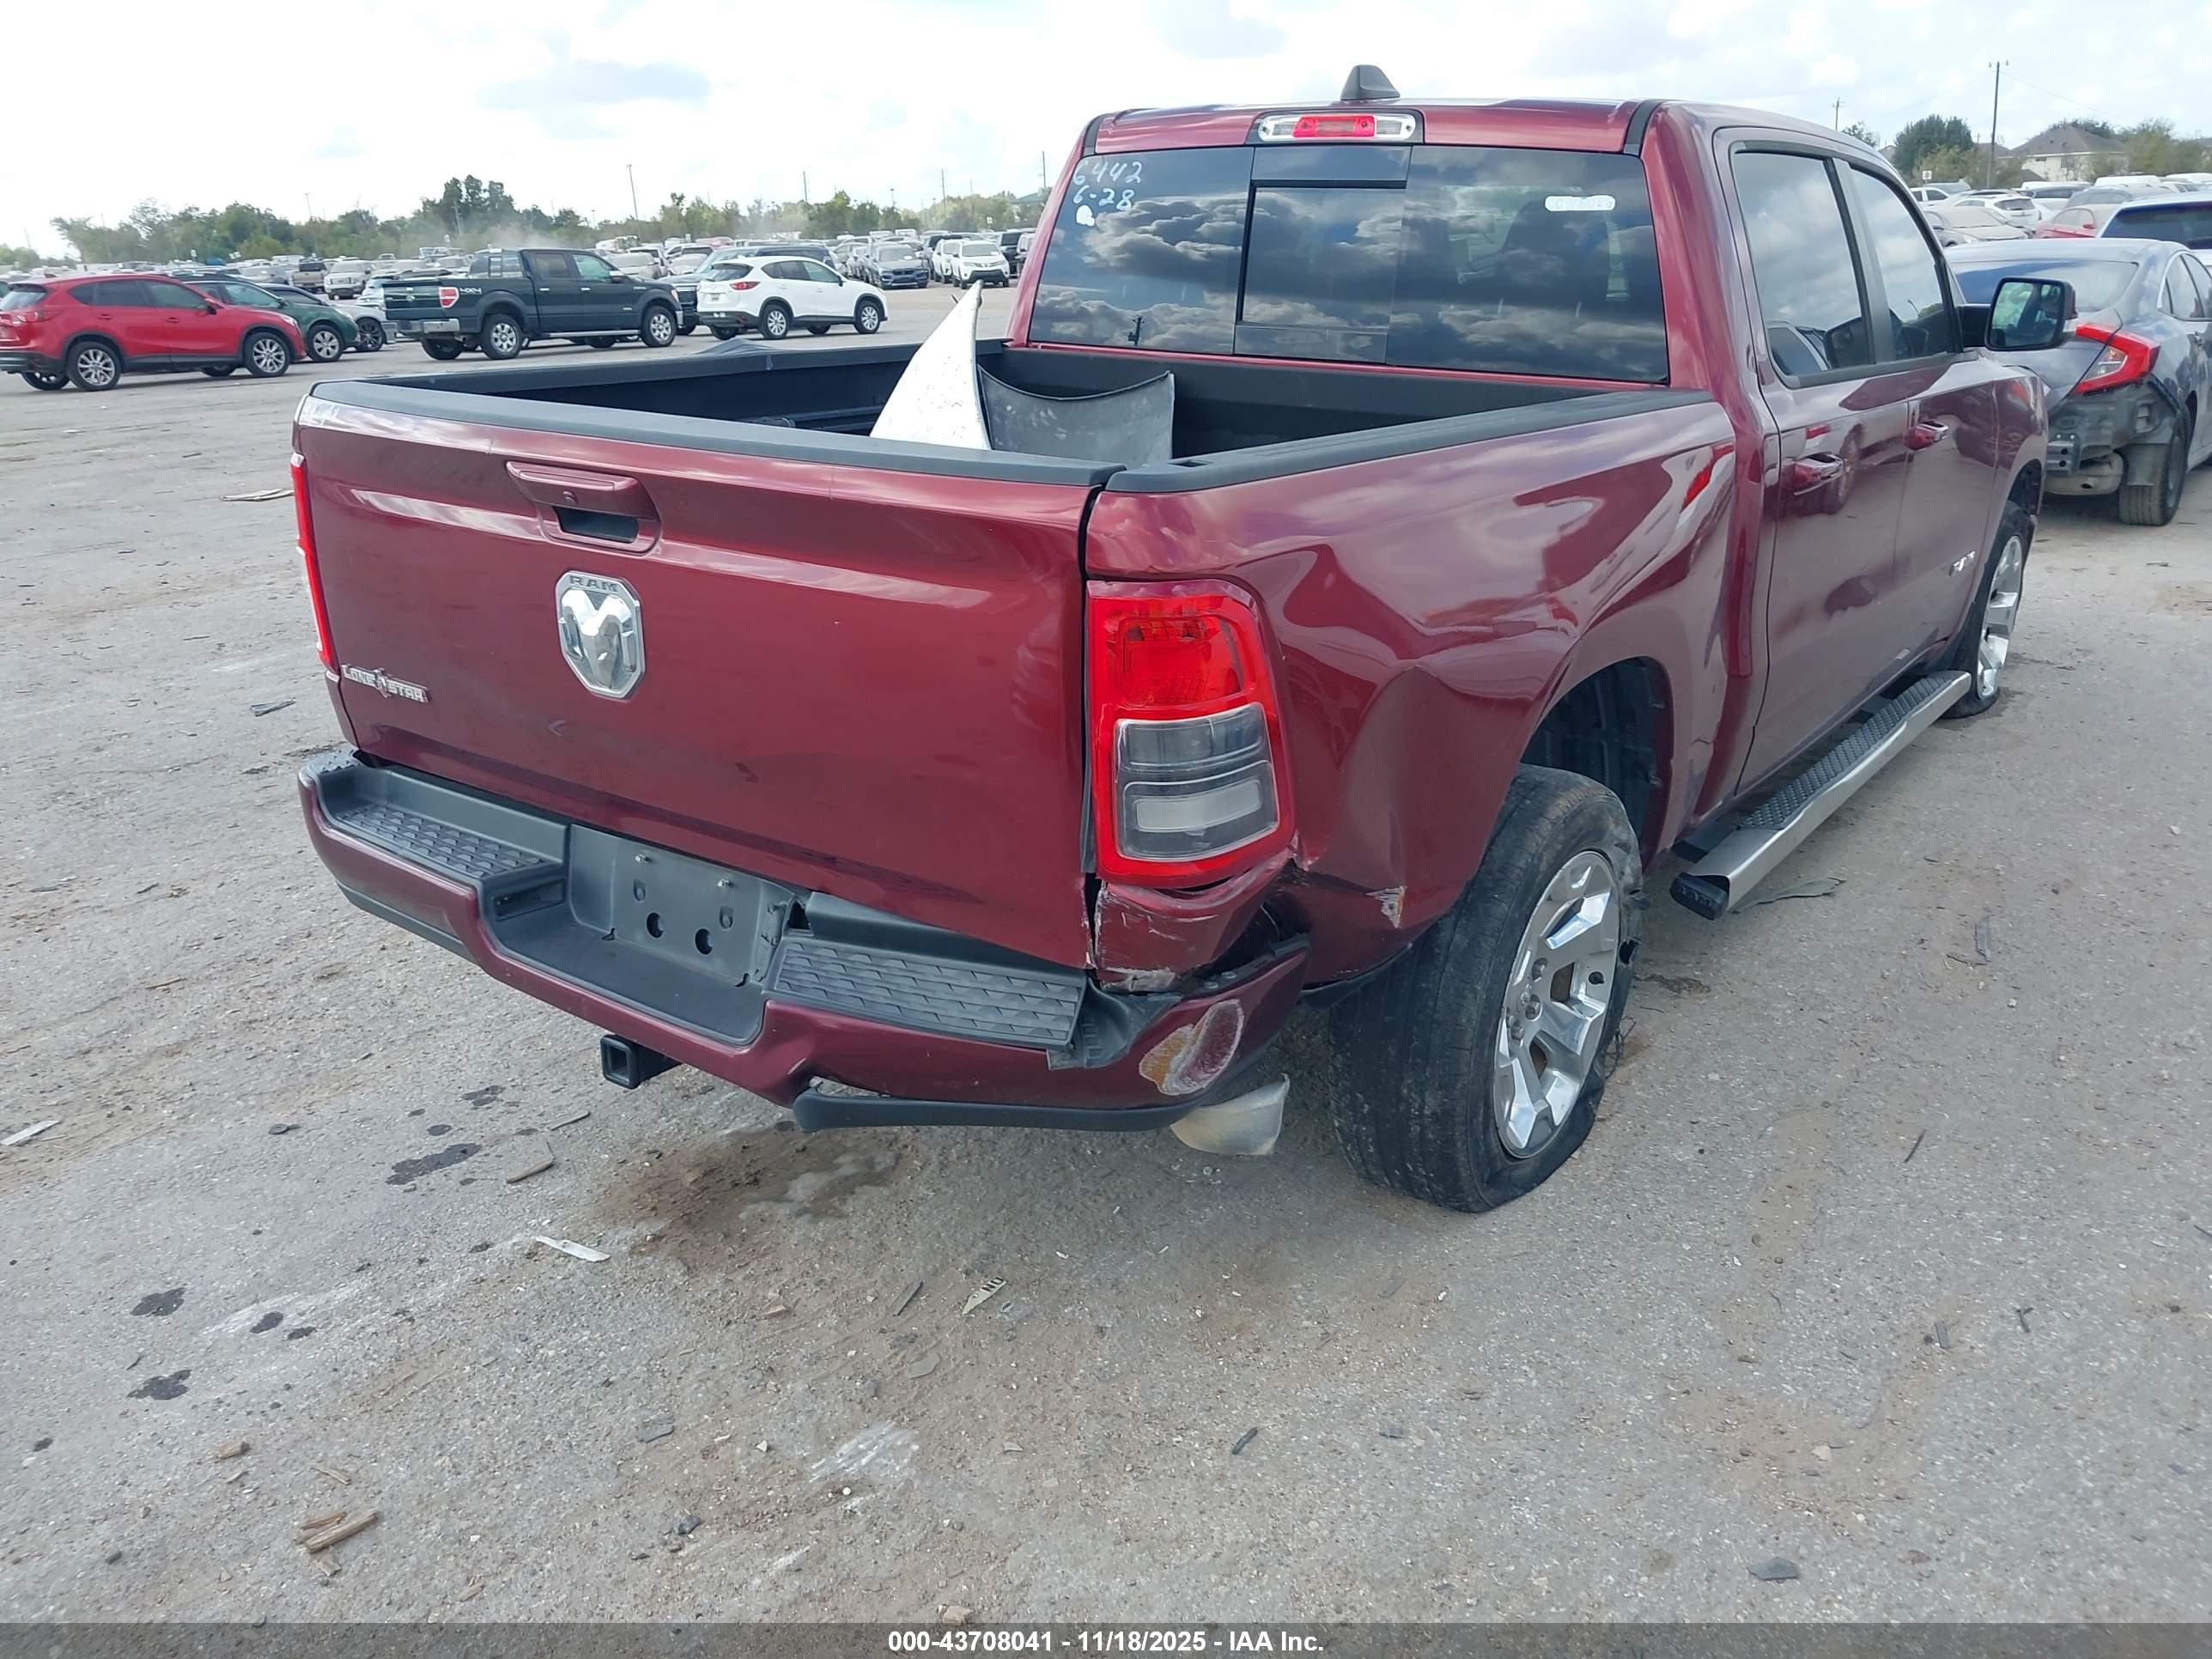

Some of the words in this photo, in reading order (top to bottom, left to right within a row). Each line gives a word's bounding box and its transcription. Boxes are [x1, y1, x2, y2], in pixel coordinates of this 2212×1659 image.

[1074, 161, 1142, 185] 6442
[569, 575, 618, 592] RAM
[341, 664, 376, 687] LONE
[386, 678, 428, 703] STAR
